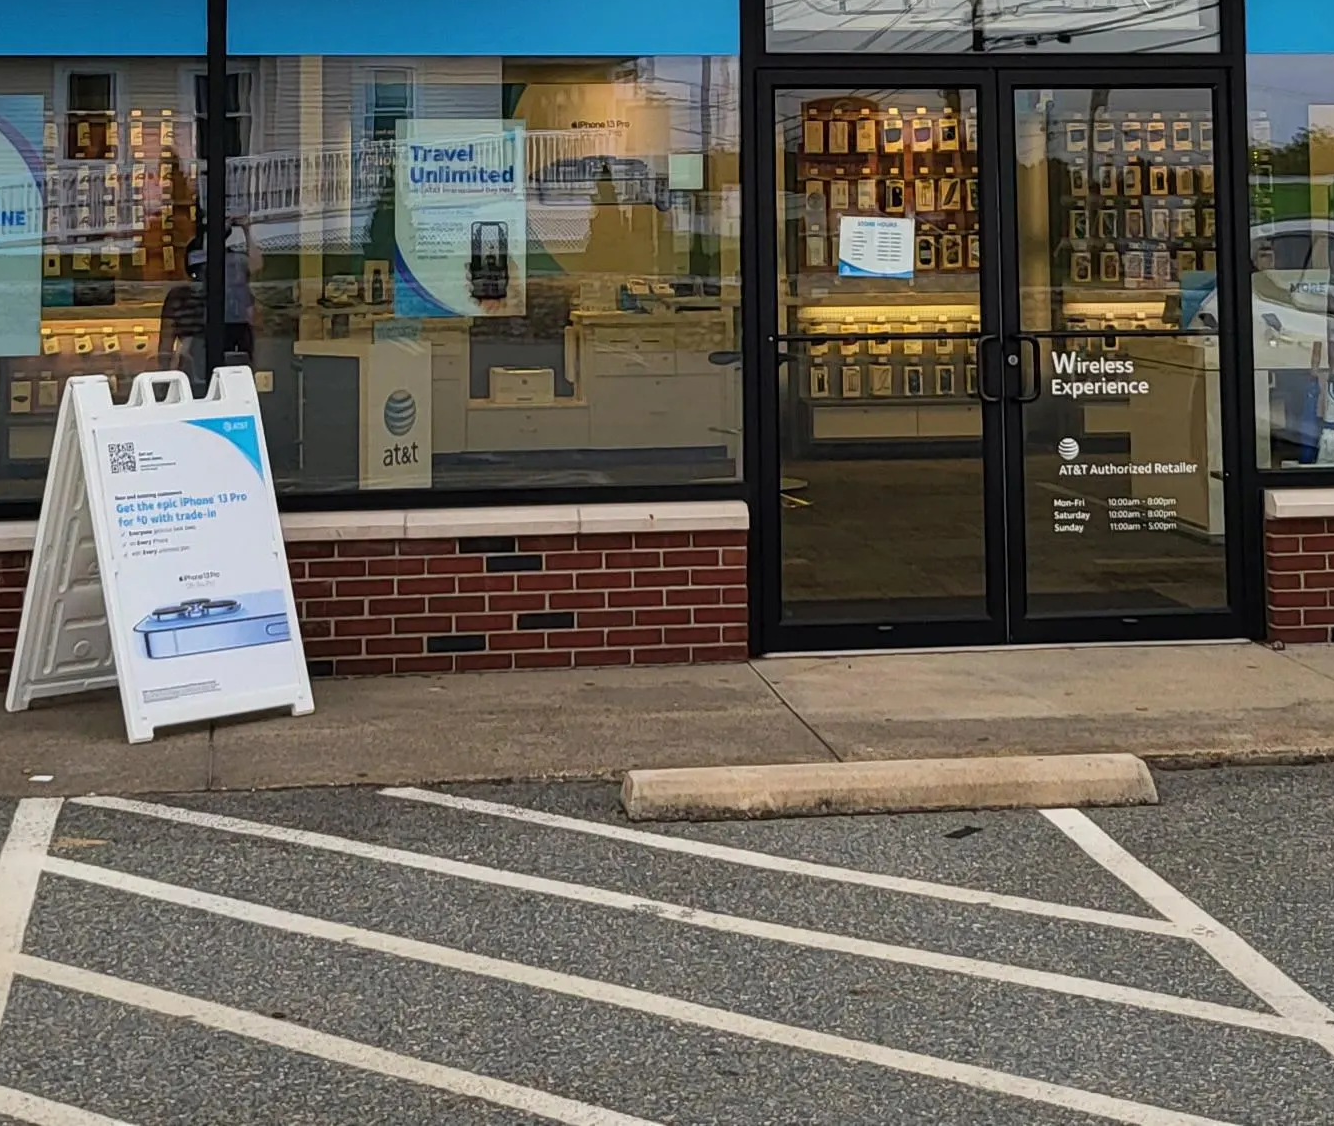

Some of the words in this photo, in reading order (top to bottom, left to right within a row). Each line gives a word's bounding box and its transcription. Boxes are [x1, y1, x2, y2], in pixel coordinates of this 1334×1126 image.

[410, 143, 474, 162] Travel
[410, 164, 514, 184] Unlimited
[1051, 351, 1135, 375] Wireless
[1051, 377, 1150, 399] Experience
[382, 441, 419, 467] at&t
[1058, 464, 1088, 475] AT&T
[1089, 462, 1152, 475] Authorized
[1154, 461, 1198, 474] Retailer
[116, 502, 135, 514] Get
[137, 501, 155, 512] the
[157, 498, 178, 511] epic
[180, 495, 215, 508] iPhone
[217, 494, 228, 504] 13
[230, 492, 248, 502] Pro
[1053, 498, 1086, 507] Mon-Fri
[118, 516, 133, 528] for
[136, 515, 148, 526] $0
[150, 512, 174, 524] with
[176, 508, 217, 522] trade-in
[1053, 511, 1091, 521] Saturday
[1054, 523, 1084, 534] Sunday
